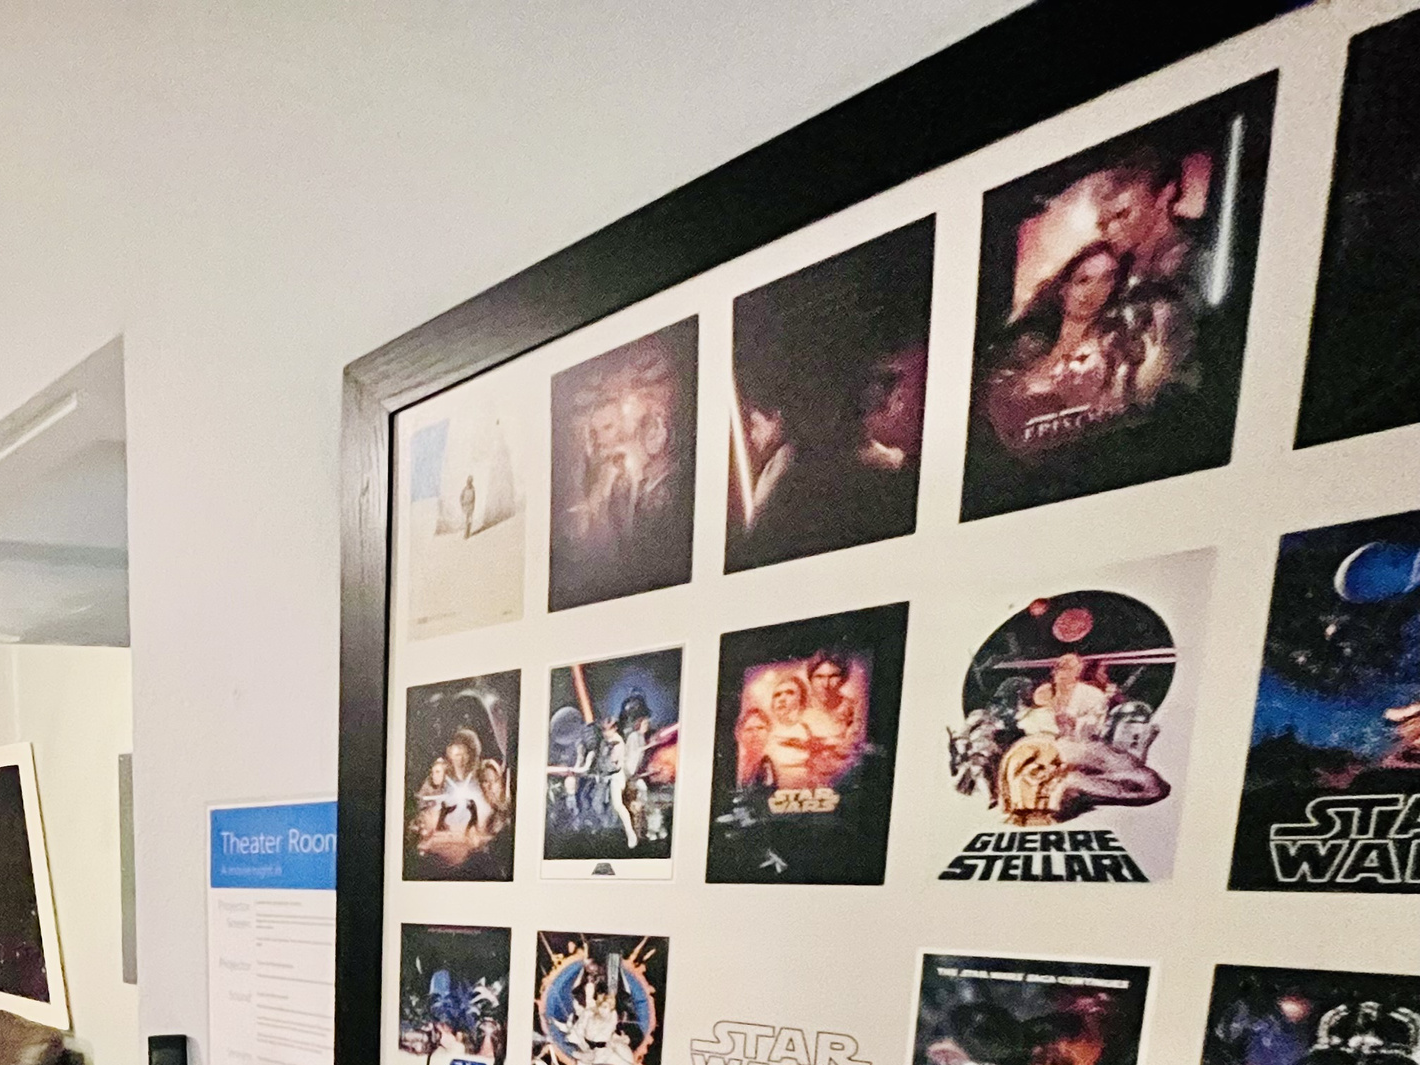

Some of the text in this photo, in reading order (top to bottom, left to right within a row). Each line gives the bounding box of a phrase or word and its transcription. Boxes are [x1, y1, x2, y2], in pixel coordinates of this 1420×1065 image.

[221, 831, 283, 855] Theater
[961, 830, 1127, 853] GUERRE
[936, 853, 1151, 884] STELLARI
